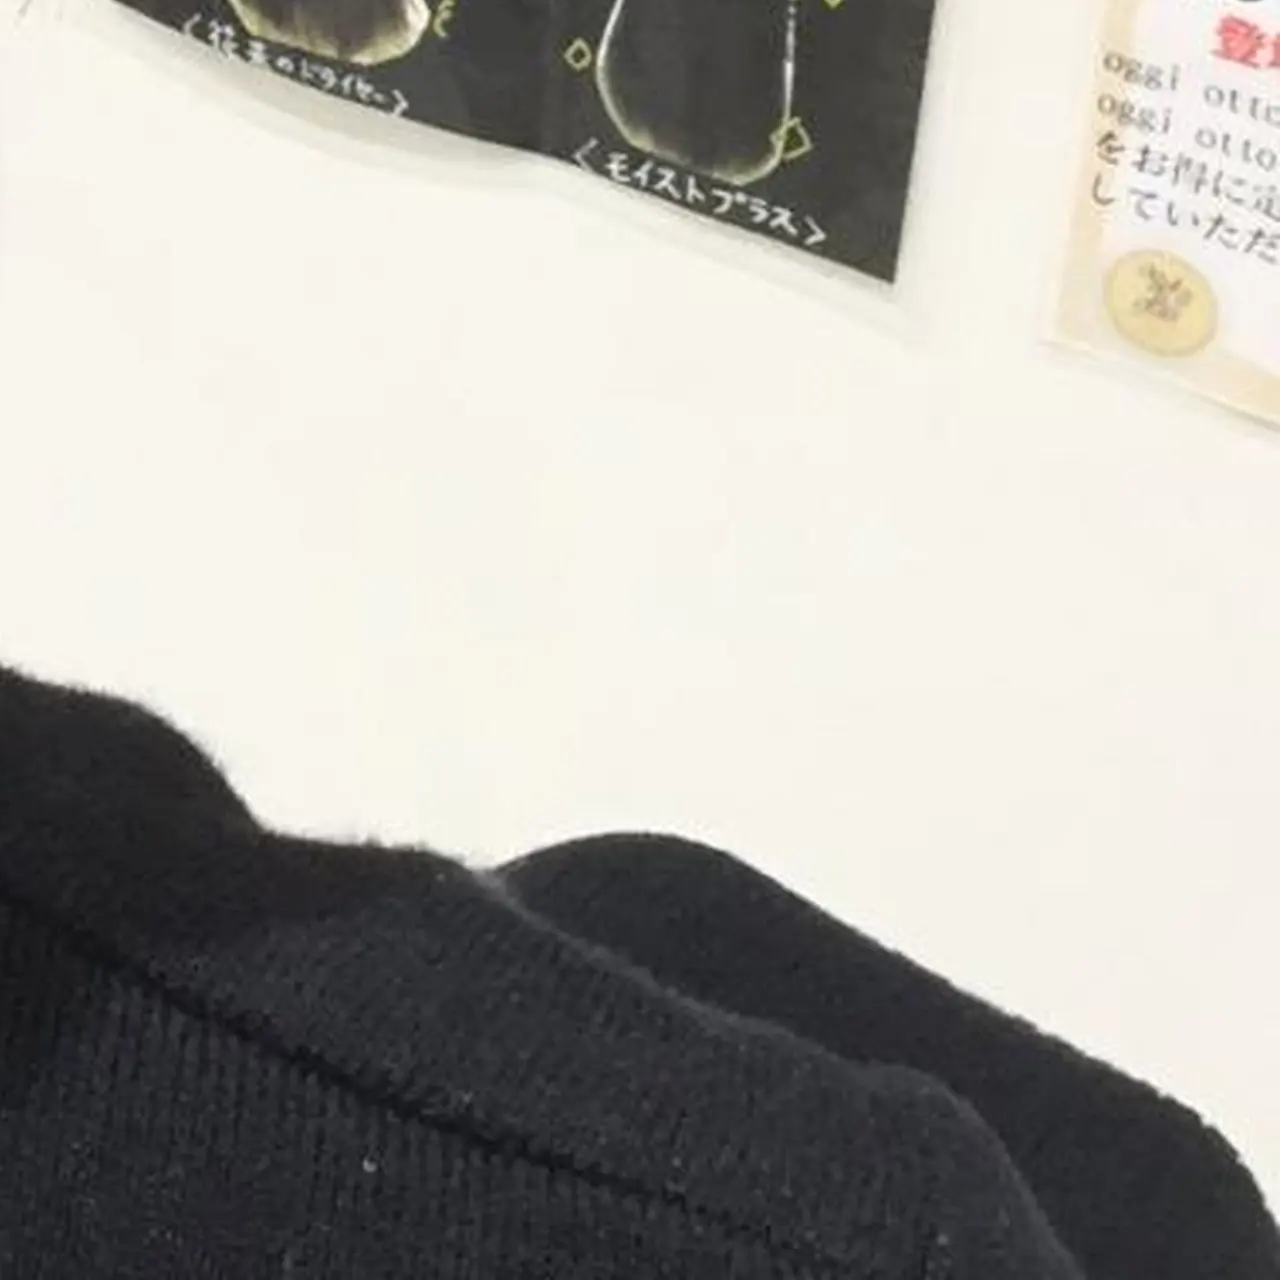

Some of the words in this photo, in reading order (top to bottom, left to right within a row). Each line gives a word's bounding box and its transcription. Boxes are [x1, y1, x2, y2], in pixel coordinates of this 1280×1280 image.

[1210, 13, 1280, 70] 登
[1102, 49, 1180, 91] oggi
[1096, 93, 1172, 133] oggi
